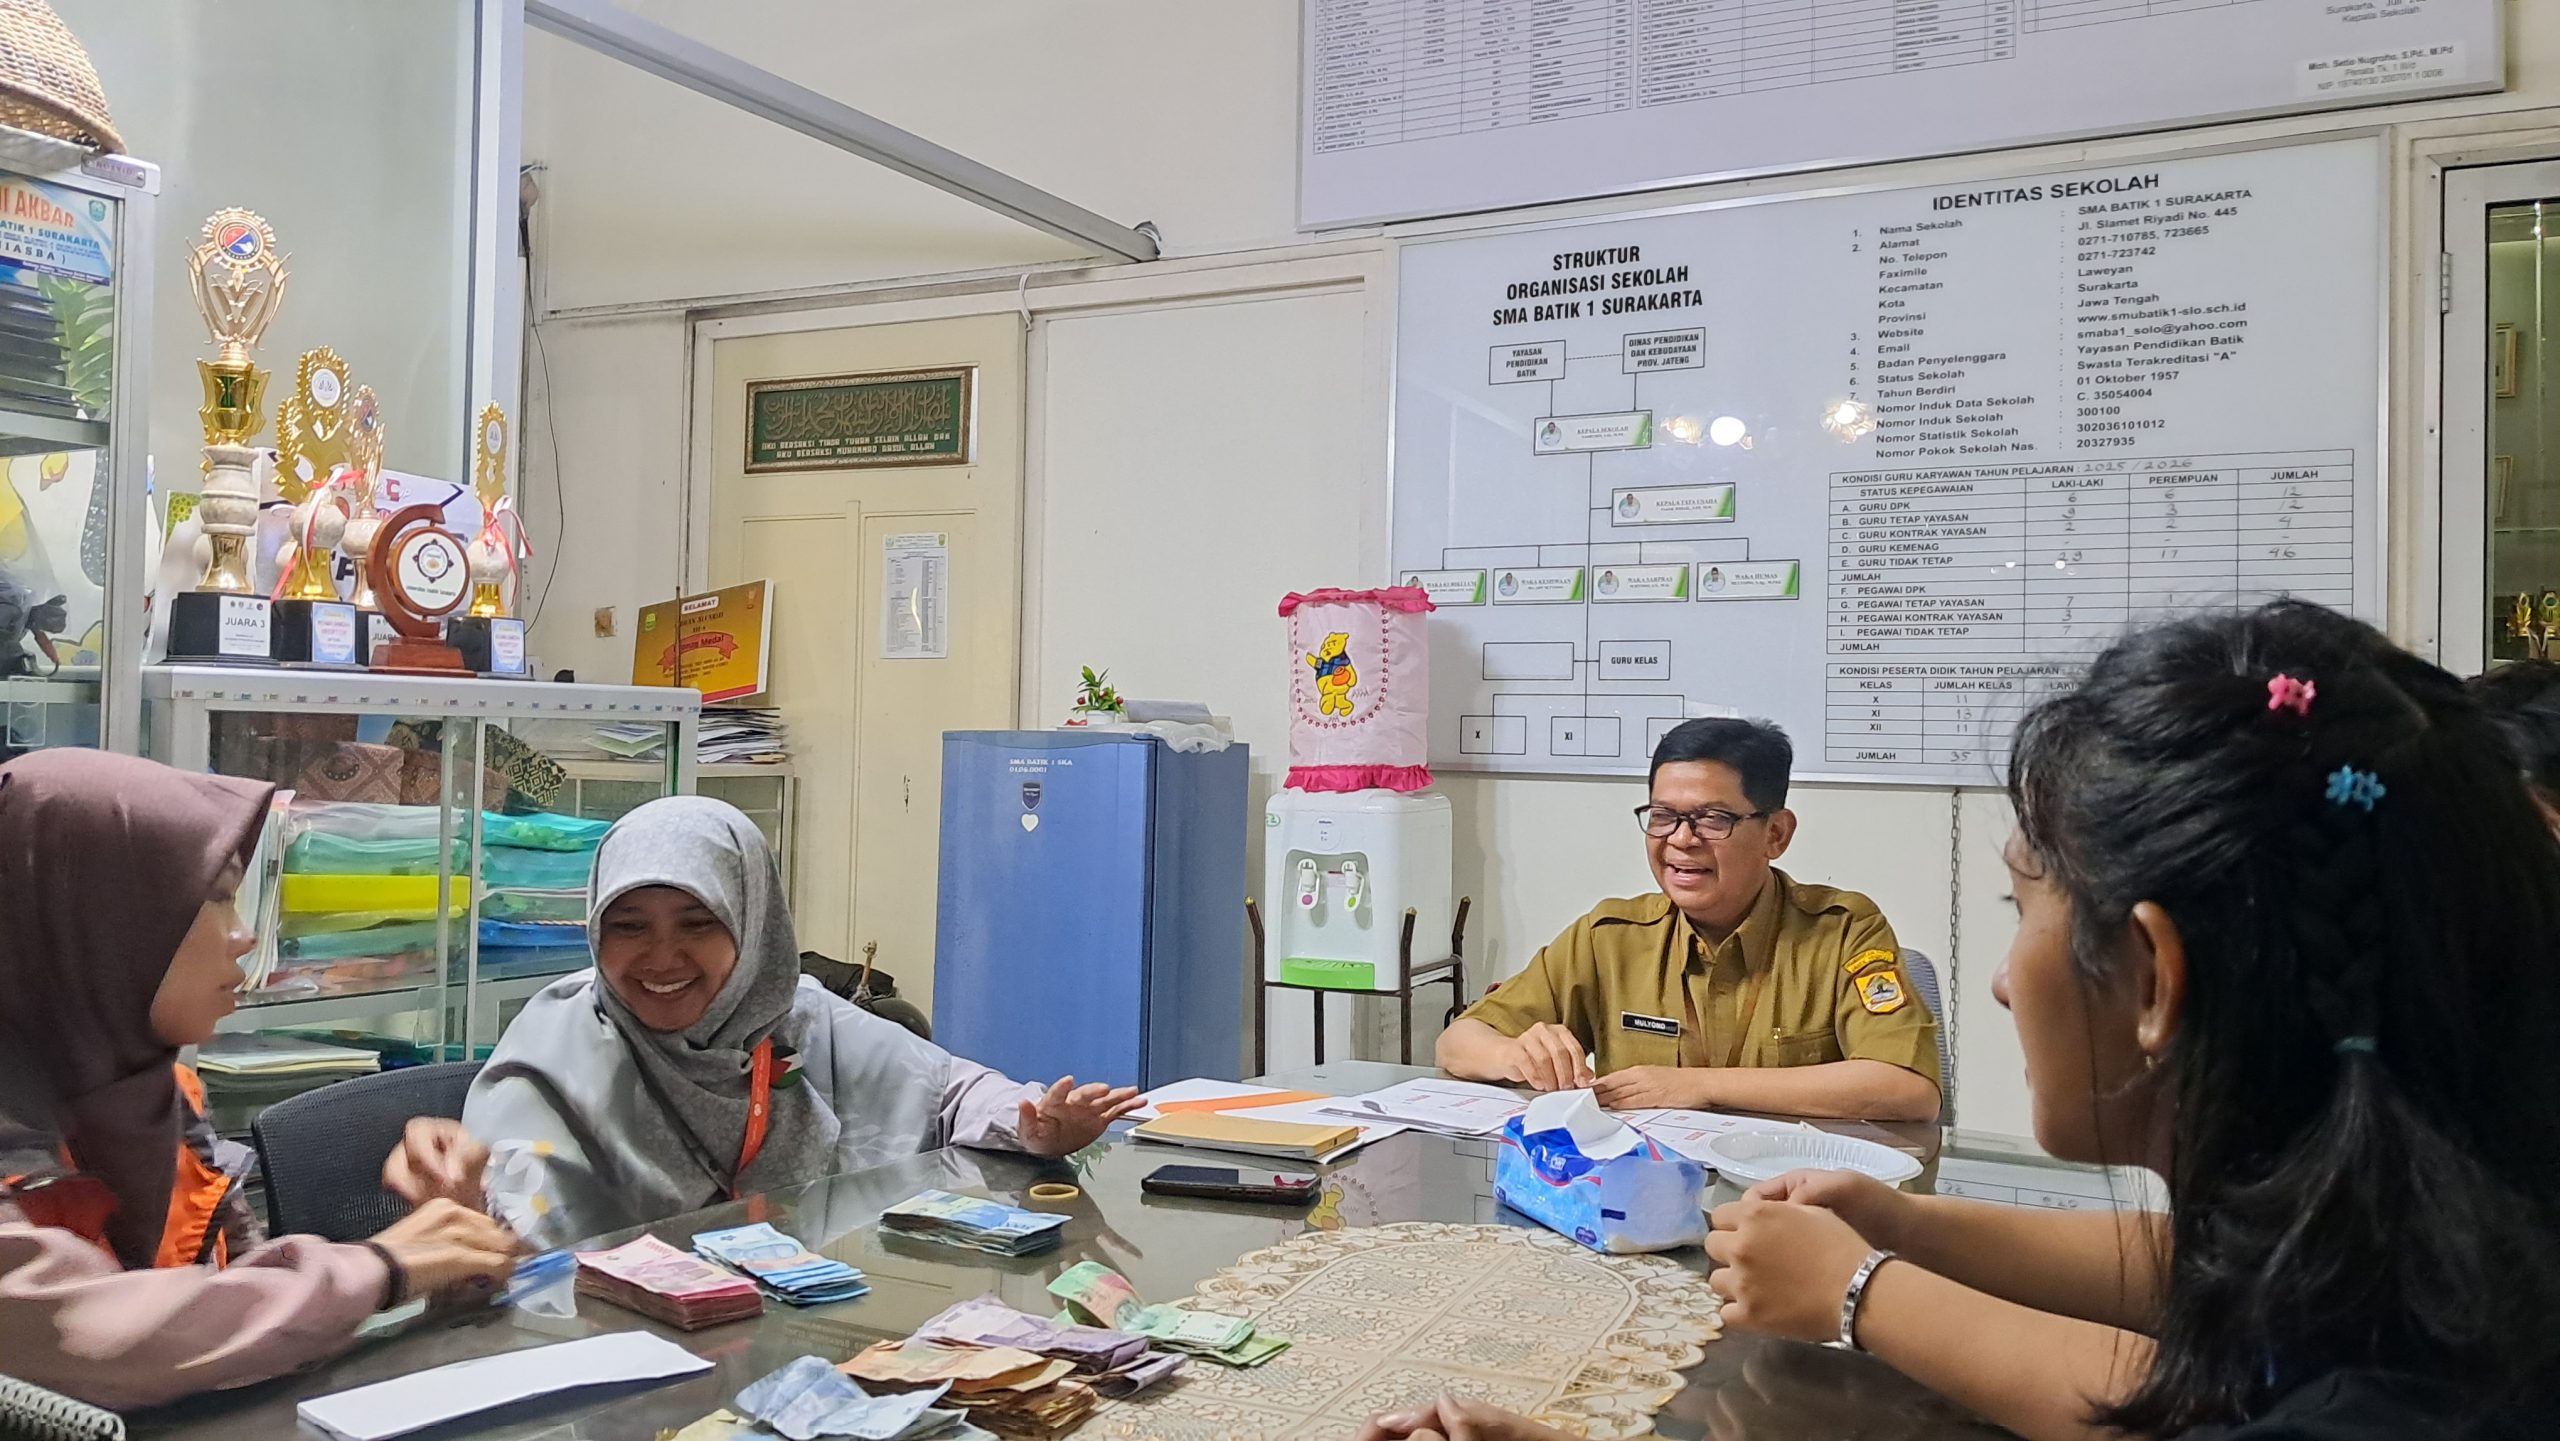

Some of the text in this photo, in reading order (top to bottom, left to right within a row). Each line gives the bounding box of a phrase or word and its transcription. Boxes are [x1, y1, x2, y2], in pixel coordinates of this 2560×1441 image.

[1932, 173, 2159, 211] IDENTITAS SEKOLAH
[15, 190, 75, 228] AKBAR
[2077, 189, 2253, 216] SMA BATIK 1 SURAKARTA
[2077, 206, 2238, 231] Jl. Slamet Riyadi No. 445
[1879, 218, 1964, 236] Nama Sekolah
[38, 229, 100, 249] SURAKARTA
[2077, 225, 2210, 247] 0271-710785, 723665
[1879, 238, 1920, 250] Alamat
[1552, 245, 1640, 272] STRUKTUR
[1901, 251, 1948, 263] Telepon
[2077, 245, 2157, 262] 0271-723742
[1878, 267, 1928, 280] Faximile
[2077, 265, 2134, 278] Laweyan
[1506, 265, 1689, 301] ORGANISASI SEKOLAH
[1878, 282, 1944, 295] Kecamatan
[2077, 280, 2139, 293] Surakarta
[1878, 299, 1906, 310] Kota
[2077, 293, 2160, 308] Jawa Tengah
[1492, 289, 1703, 327] SMA BATIK 1 SURAKARTA
[2077, 302, 2247, 323] www.smubatik1-slo.sch.id
[1877, 311, 1927, 324] Provinsi
[1877, 328, 1925, 339] Website
[2077, 319, 2248, 339] smaba1_solo@yahoo.com
[1628, 333, 1700, 348] DINAS PENDIDIKAN
[2077, 334, 2244, 356] Yayasan Pendidikan Batik
[1512, 347, 1543, 358] YAYASAN
[1630, 344, 1697, 358] DAN KEBUDAYAAN
[1877, 343, 1911, 355] Email
[1505, 357, 1549, 369] PENDIDIKAN
[1636, 355, 1690, 368] PROV. JATENG
[1877, 352, 2007, 370] Badan Penyelenggara
[2076, 350, 2237, 370] Swasta Terakreditasi "A"
[1516, 368, 1537, 378] BATIK
[1876, 369, 1965, 384] Status Sekolah
[2076, 370, 2180, 386] 01 Oktober 1957
[1876, 385, 1956, 399] Tahun Berdiri
[2076, 387, 2153, 402] C. 35054004
[1876, 395, 2035, 414] Nomor Induk Data Sekolah
[2076, 405, 2121, 417] 300100
[1876, 412, 2004, 429] Nomor Induk Sekolah
[2076, 418, 2166, 433] 302036101012
[1875, 427, 2019, 444] Nomor Statistik Sekolah
[2076, 436, 2136, 449] 20327935
[1875, 442, 2038, 459] Nomor Pokok Sekolah Nas.
[1841, 464, 2075, 484] KONDISI GURU KARYAWAN TAHUN PELAJARAN
[2148, 473, 2219, 485] PEREMPUAN
[2270, 469, 2319, 481] JUMLAH
[2051, 478, 2104, 489] LAKI-LAKI
[1859, 483, 1974, 498] STATUS KEPEGAWAIAN
[1858, 501, 1911, 512] GURU DPK
[1858, 513, 1969, 526] GURU TETAP YAYASAN
[1858, 527, 1987, 540] GURU KONTRAK YAYASAN
[684, 599, 716, 612] SELAMAT
[225, 616, 266, 629] JUARA 3
[701, 636, 724, 647] Medal
[1610, 656, 1659, 665] GURU KELAS
[1839, 665, 2060, 676] KONDISI PESERTA DIDIK TAHUN PELAJARAN
[1859, 680, 1893, 690] KELAS
[1933, 680, 2013, 690] JUMLAH KELAS
[1474, 729, 1481, 740] X
[1564, 731, 1574, 741] XI
[1855, 751, 1897, 761] JUMLAH
